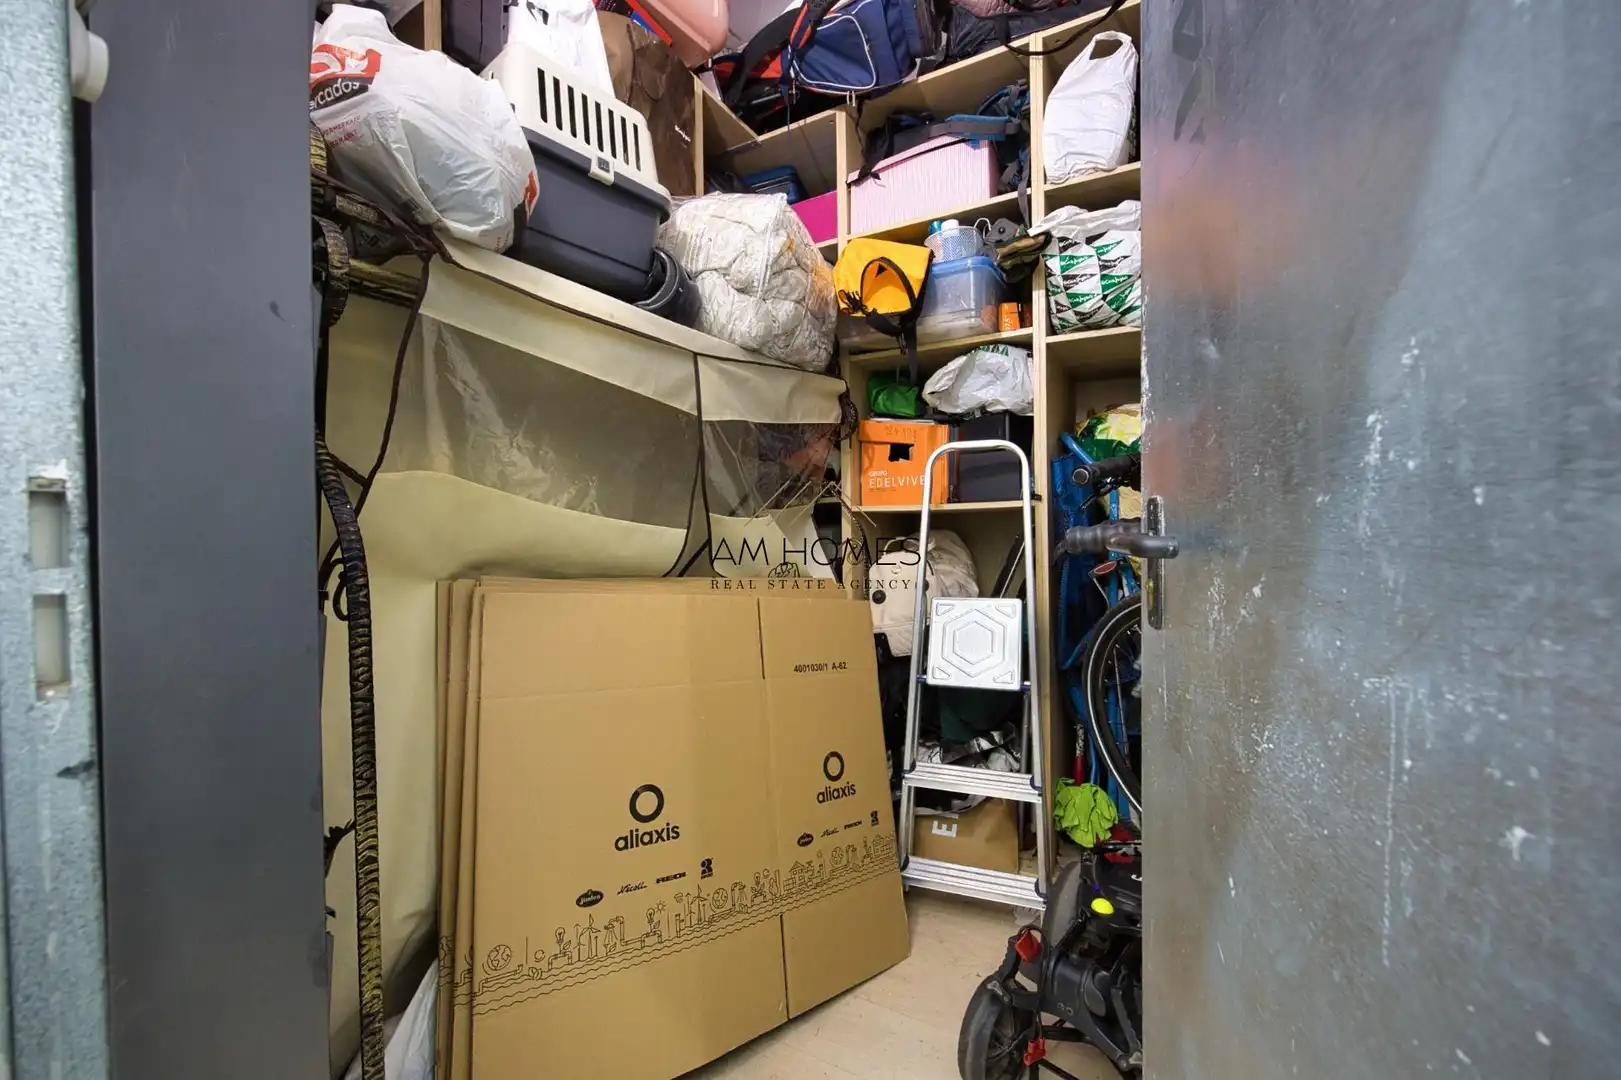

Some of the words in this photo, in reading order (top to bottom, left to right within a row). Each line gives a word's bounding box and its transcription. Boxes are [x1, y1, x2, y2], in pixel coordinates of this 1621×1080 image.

[794, 663, 828, 673] 4001030/1
[816, 781, 856, 804] aliaxis
[614, 822, 681, 852] aliaxis
